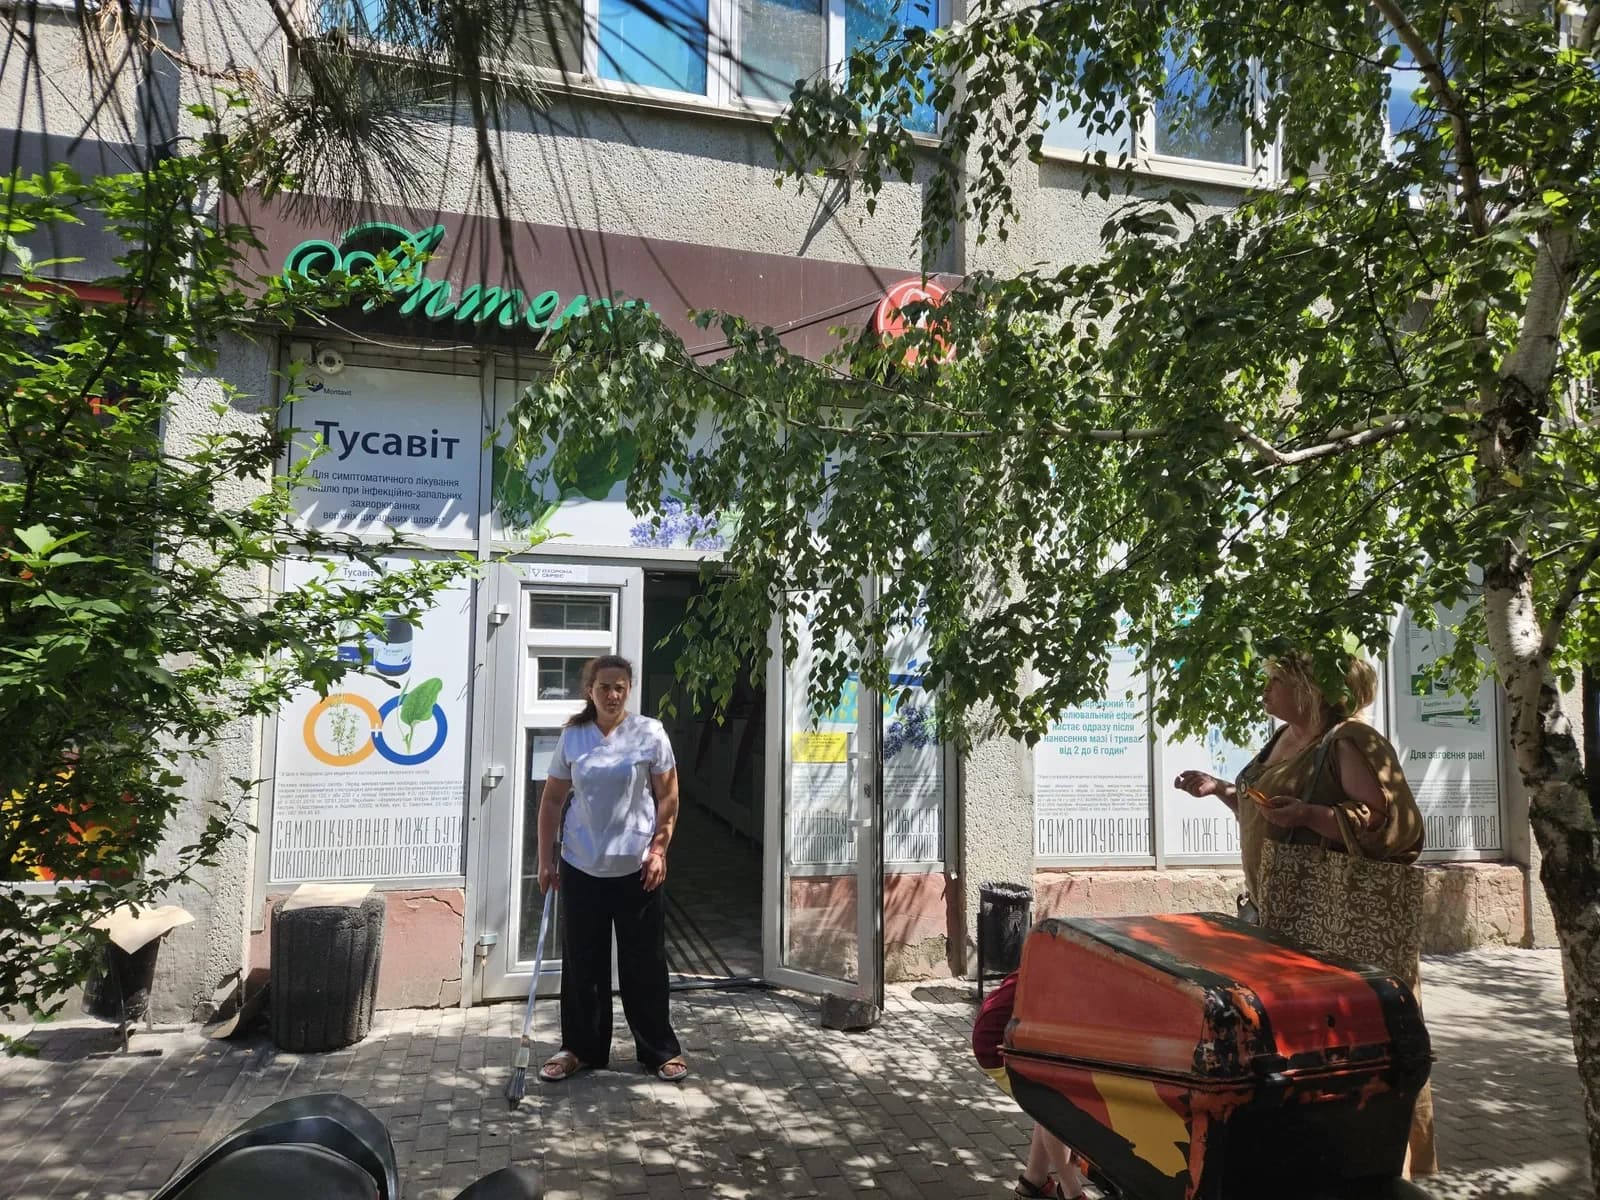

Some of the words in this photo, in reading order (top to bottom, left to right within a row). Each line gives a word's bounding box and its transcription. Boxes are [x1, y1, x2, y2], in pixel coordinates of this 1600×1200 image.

[282, 221, 656, 333] Аптек
[315, 420, 460, 461] Тусавіт
[312, 469, 329, 479] Для
[332, 471, 414, 485] симптоматичного
[416, 476, 460, 488] лікування
[342, 486, 359, 496] при
[343, 567, 375, 577] Тусавіт
[1061, 711, 1115, 720] олювальний
[1082, 723, 1111, 733] одразу
[1112, 722, 1135, 731] після
[1044, 735, 1087, 743] нанесення
[1089, 734, 1108, 743] мазі
[1059, 746, 1072, 756] від
[1074, 745, 1080, 755] 2
[1081, 747, 1091, 756] до
[1093, 746, 1099, 755] 6
[1410, 749, 1426, 760] Для
[1468, 750, 1485, 762] ран!
[276, 818, 389, 850] САМОЛІКУВАННЯ
[394, 816, 430, 846] МОЖЕ
[435, 815, 464, 845] БУТИ
[1039, 818, 1151, 854] САМОЛІКУВАННЯ
[1182, 818, 1219, 852] МОЖЕ
[1226, 818, 1241, 851] БУ
